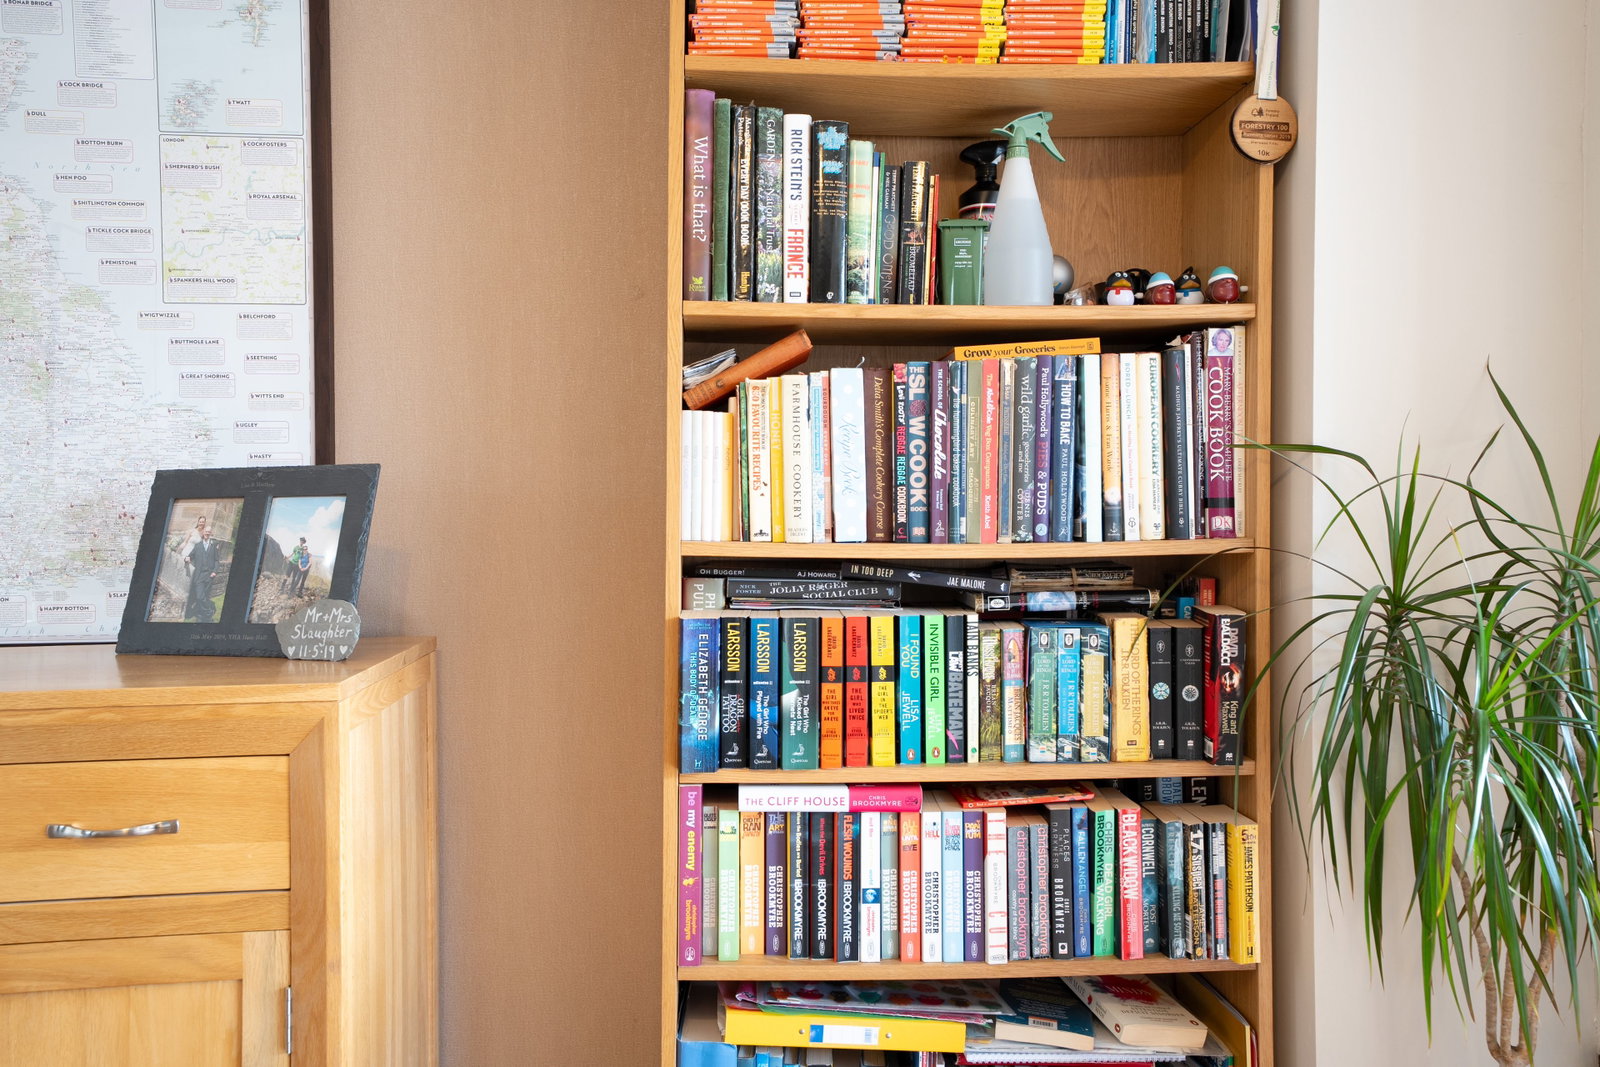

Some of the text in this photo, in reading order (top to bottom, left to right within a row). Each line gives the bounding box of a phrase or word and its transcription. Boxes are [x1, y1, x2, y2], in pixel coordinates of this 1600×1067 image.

[1241, 122, 1275, 131] FORESTRY
[692, 136, 709, 242] What is that?
[766, 119, 775, 253] GARDENS National Trust
[790, 129, 803, 201] RICK STEIN'S
[787, 228, 804, 279] FRANCE
[908, 246, 916, 292] BROMELIAD
[740, 271, 750, 293] Hamlyn
[909, 366, 925, 374] THE
[963, 344, 1056, 358] Grow your Groceries
[771, 412, 781, 450] HONEY
[1060, 384, 1071, 445] HOW TO BAKE
[1149, 357, 1160, 476] EUROPEAN COOKERY
[1208, 366, 1225, 481] COOK BOOK
[752, 403, 761, 491] FAVOURITE RECIPES
[792, 383, 802, 520] FARMHOUSE COOKERY
[838, 418, 861, 497] Recipe Book
[872, 376, 885, 529] Delia Smith's Complete Cookery Course
[1037, 367, 1050, 515] Paul Hollywood's PIES & PUDS
[1023, 489, 1031, 518] DENIS
[1214, 516, 1231, 528] DK
[802, 587, 879, 599] SOCIAL CLUB
[851, 564, 894, 578] IN TOO DEEP
[946, 576, 986, 590] JAE MALONE
[291, 623, 352, 647] Slaughter
[727, 622, 741, 672] LARSSON
[756, 623, 770, 673] LARSSON
[793, 623, 807, 672] LARSSON
[901, 644, 910, 668] YOU
[967, 621, 979, 677] IAIN BANKS
[1220, 618, 1231, 666] BALDACCI
[1229, 627, 1239, 658] DAVID
[698, 633, 709, 694] ELIZABETH
[930, 624, 939, 702] INVISIBLE GIRL
[697, 698, 709, 741] GEORGE
[722, 694, 730, 733] TATTOO
[729, 694, 737, 733] DRAGON
[902, 691, 911, 731] JEWELL
[910, 700, 919, 723] LISA
[1221, 701, 1231, 734] Maxwell
[1228, 700, 1239, 734] King and
[745, 796, 845, 806] THE CLIFF HOUSE
[683, 791, 698, 871] be my enemy
[819, 839, 827, 855] Devil
[843, 815, 853, 880] FLESH WOUNDS
[1096, 815, 1105, 884] BROOKMYRE
[1105, 821, 1113, 853] CHRIS
[1122, 813, 1138, 900] BLACK WIDOW
[1142, 827, 1155, 878] CORNWELL
[768, 865, 776, 928] BROOKMYRE
[1016, 830, 1030, 959] christopher brookmyre
[1036, 827, 1049, 955] christopher brookmyre
[1078, 865, 1086, 894] ANGEL
[1104, 863, 1112, 921] DEAD GIRL
[1190, 854, 1203, 890] Suspect
[1244, 846, 1254, 913] JAMES PATTERSON
[685, 899, 693, 940] brookmyre
[794, 882, 803, 940] BROOKMYRE
[817, 882, 826, 940] BROOKMYRE
[843, 884, 852, 942] BROOKMYRE
[902, 870, 911, 933] BROOKMYRE
[910, 870, 918, 933] CHRISTOPHER
[924, 871, 932, 934] BROOKMYRE
[966, 870, 974, 933] BROOKMYRE
[1054, 878, 1065, 934] BROOKMYRE
[1096, 884, 1104, 935] WALKING
[1192, 891, 1200, 945] PATTERSON
